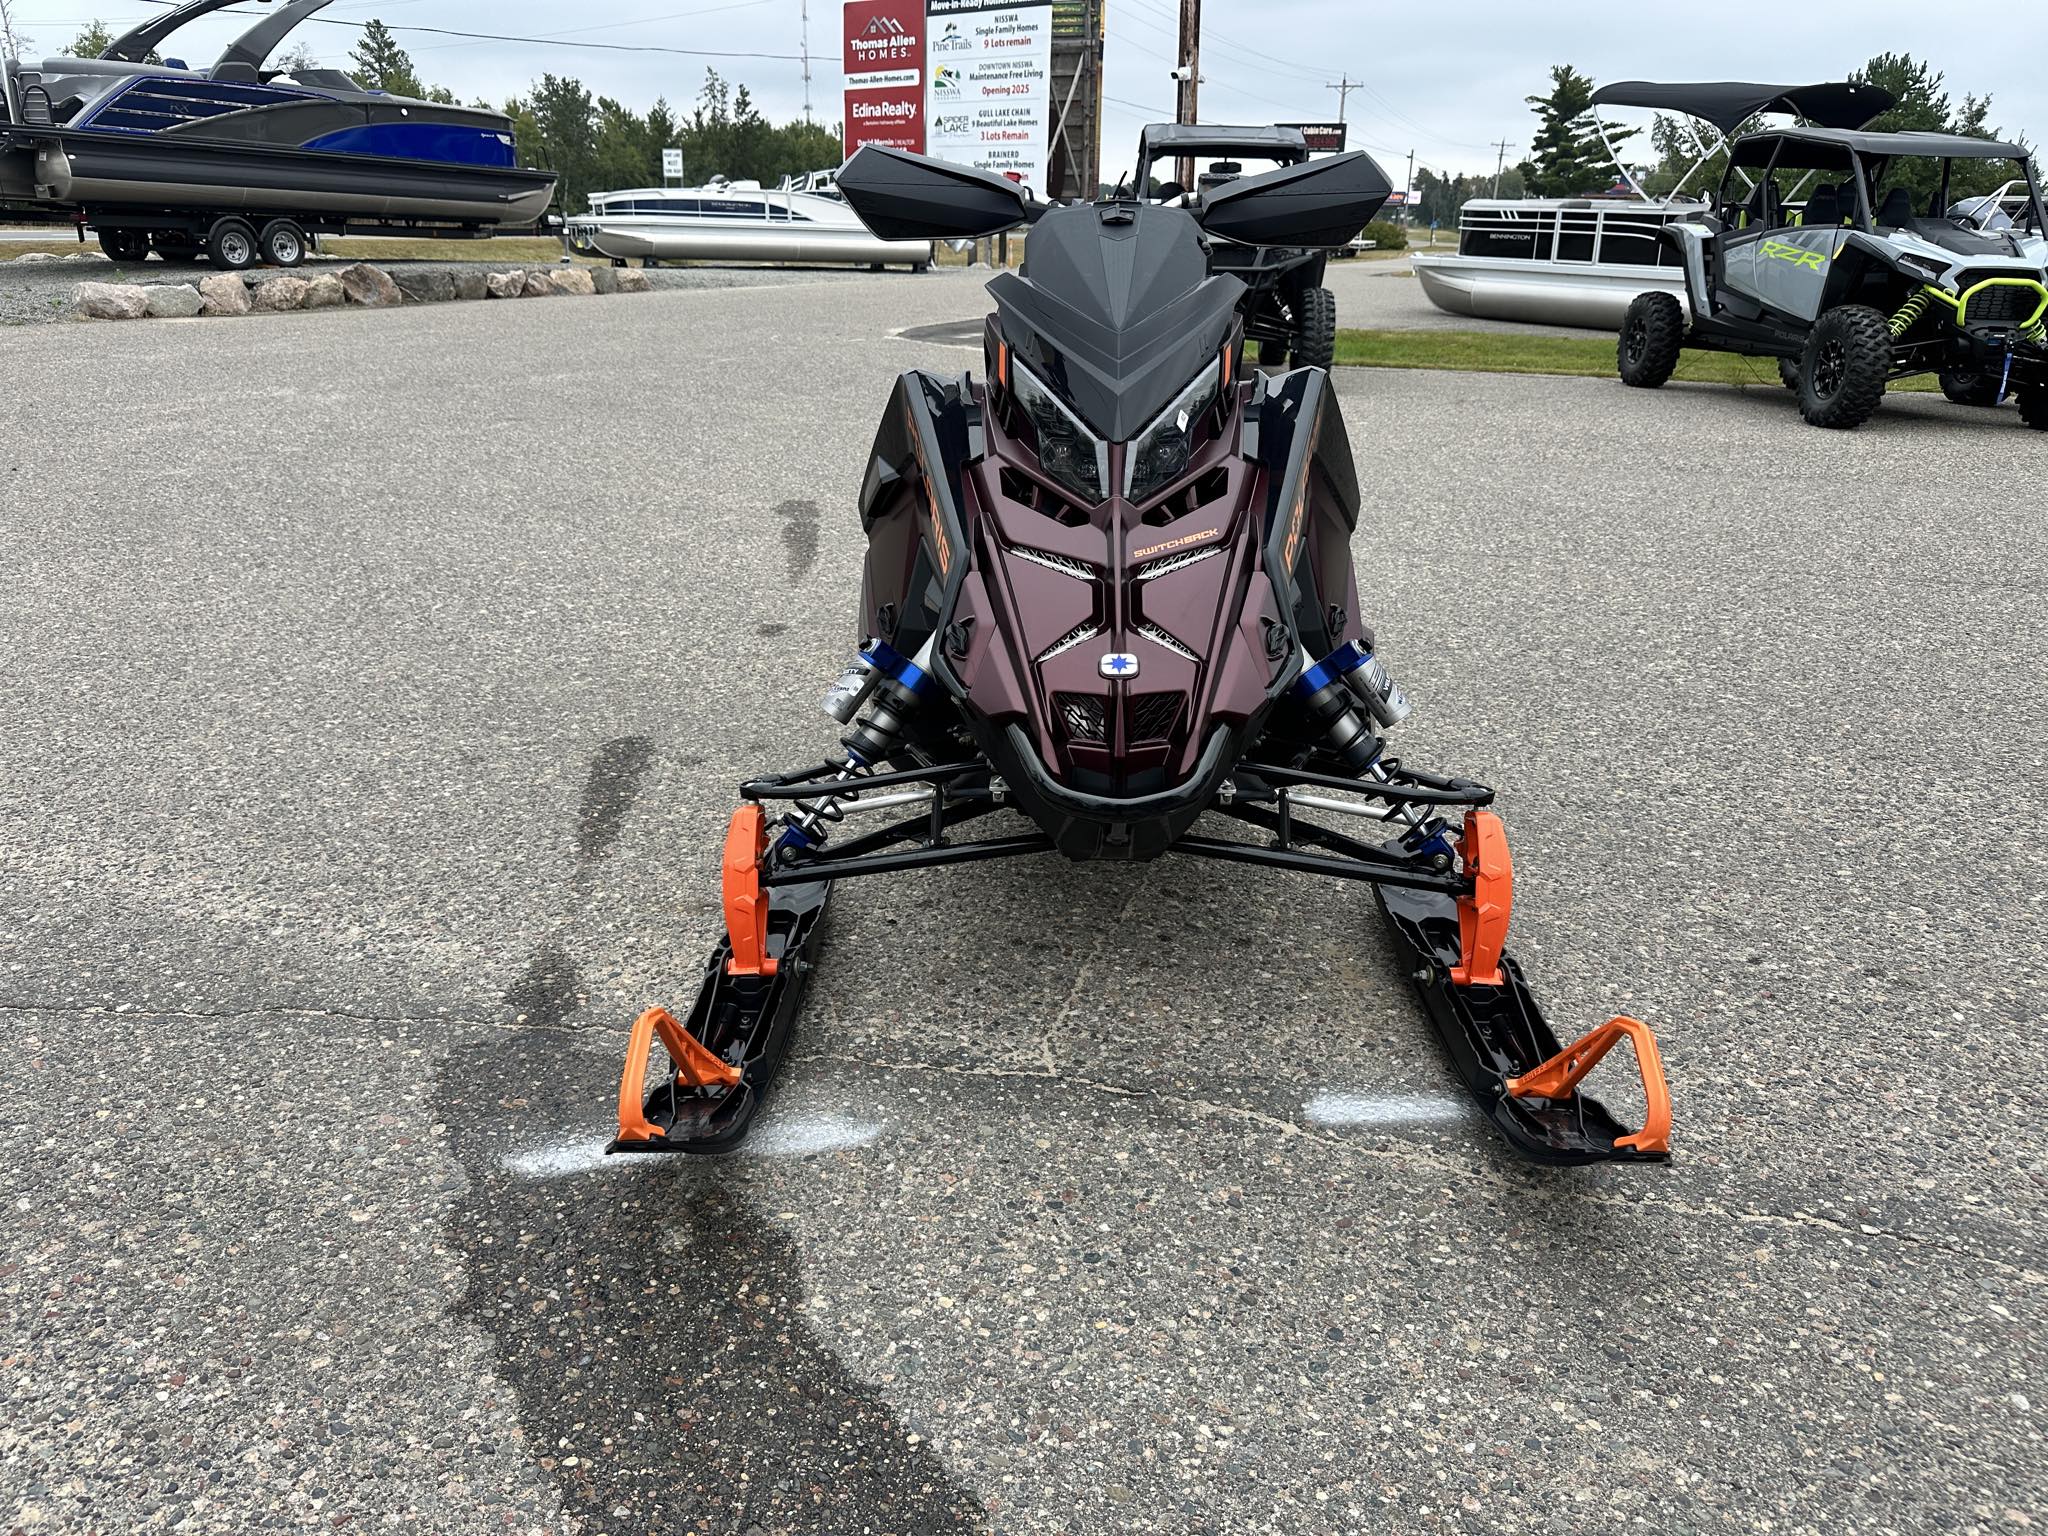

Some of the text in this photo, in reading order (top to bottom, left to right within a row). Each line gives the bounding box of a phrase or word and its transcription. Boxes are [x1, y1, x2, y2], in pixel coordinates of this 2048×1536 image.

[994, 14, 1018, 22] NISSWA
[976, 27, 994, 36] Single
[995, 24, 1015, 34] Family
[850, 35, 916, 50] Thomas Allen
[933, 38, 972, 52] Pine Trails
[984, 36, 1032, 48] 9 Lots remain
[858, 47, 906, 60] HOMES
[979, 60, 1032, 70] DOWNTOWN NISSWA
[970, 72, 1008, 80] Maintenance
[1024, 70, 1043, 79] Living
[982, 84, 1030, 96] Opening 2025
[1012, 108, 1030, 116] CHAIN
[944, 124, 968, 132] LAKE
[977, 120, 1002, 128] Beautiful
[1002, 130, 1028, 140] Remain
[1758, 241, 1826, 271] RZR
[1134, 528, 1218, 558] SWITCHBACK
